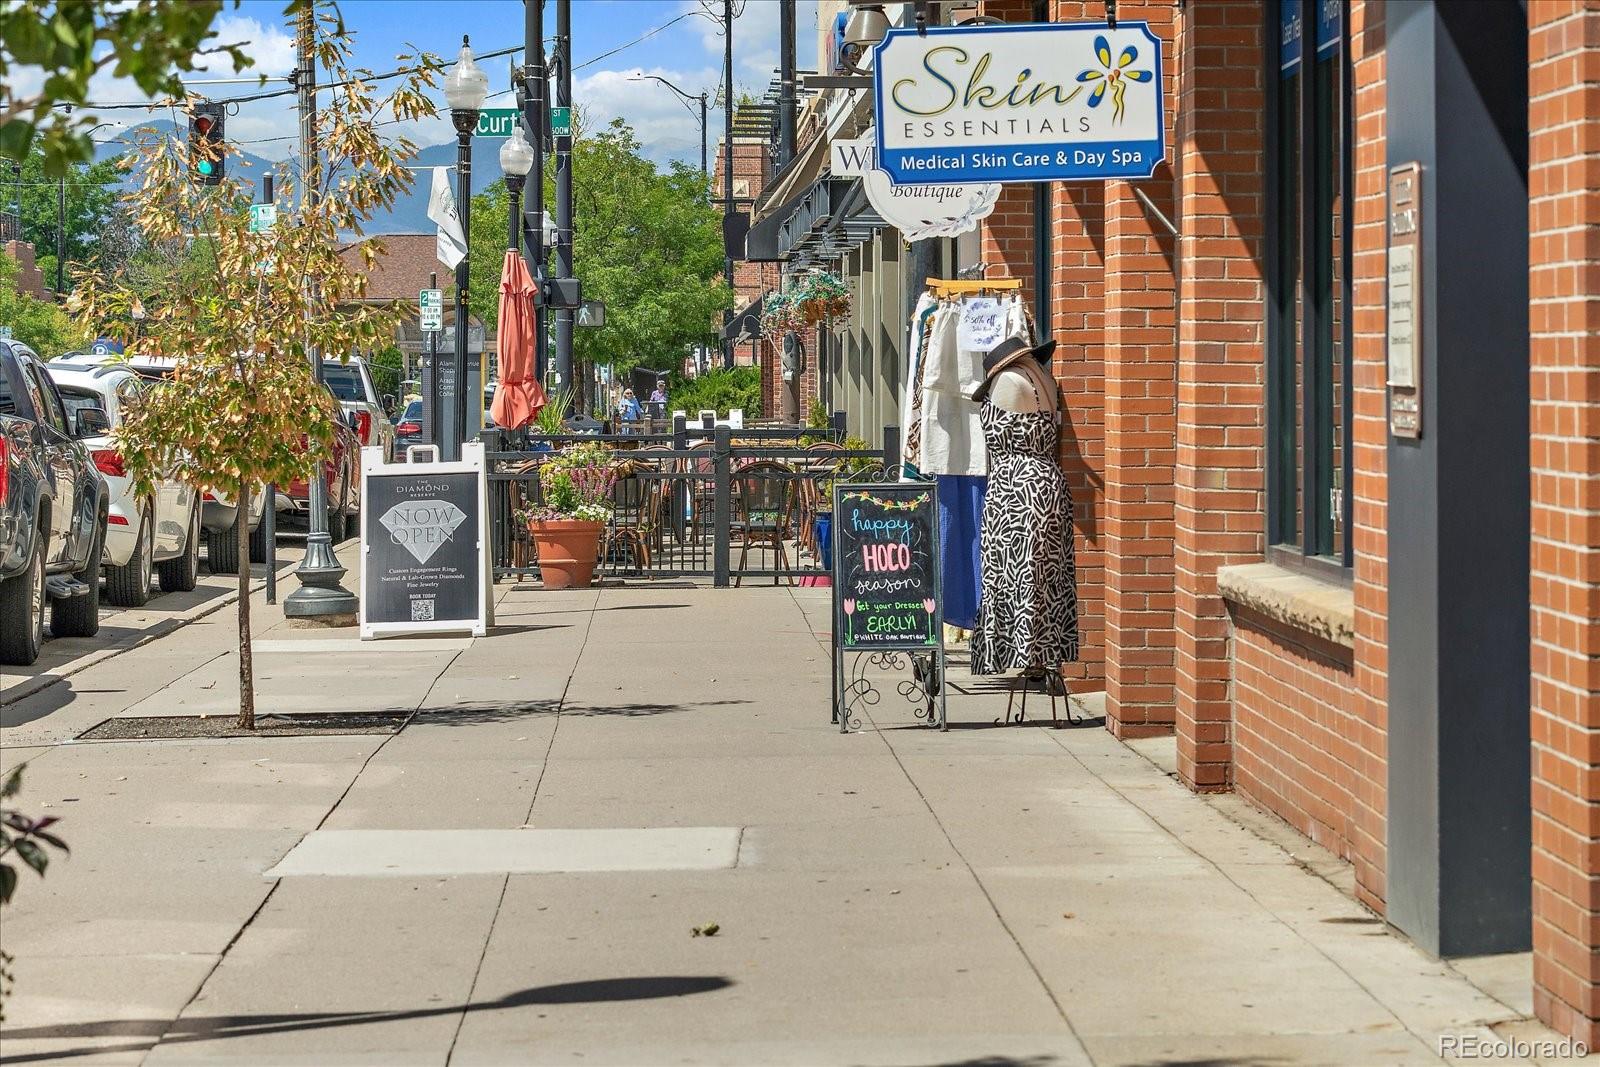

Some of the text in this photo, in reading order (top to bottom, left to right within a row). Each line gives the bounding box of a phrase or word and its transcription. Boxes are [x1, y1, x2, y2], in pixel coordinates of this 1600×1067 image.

[892, 46, 1083, 117] Skin
[477, 112, 518, 133] Curt
[904, 117, 1090, 138] ESSENTIALS
[901, 148, 1142, 170] Medical Skin Care & Day Spa
[893, 185, 963, 203] Boutique
[396, 484, 450, 493] DIAMOND
[394, 507, 455, 526] NOW
[391, 527, 455, 545] OPEN
[852, 509, 914, 546] happy
[863, 543, 911, 572] HOCO
[855, 577, 921, 594] season
[873, 602, 892, 612] your
